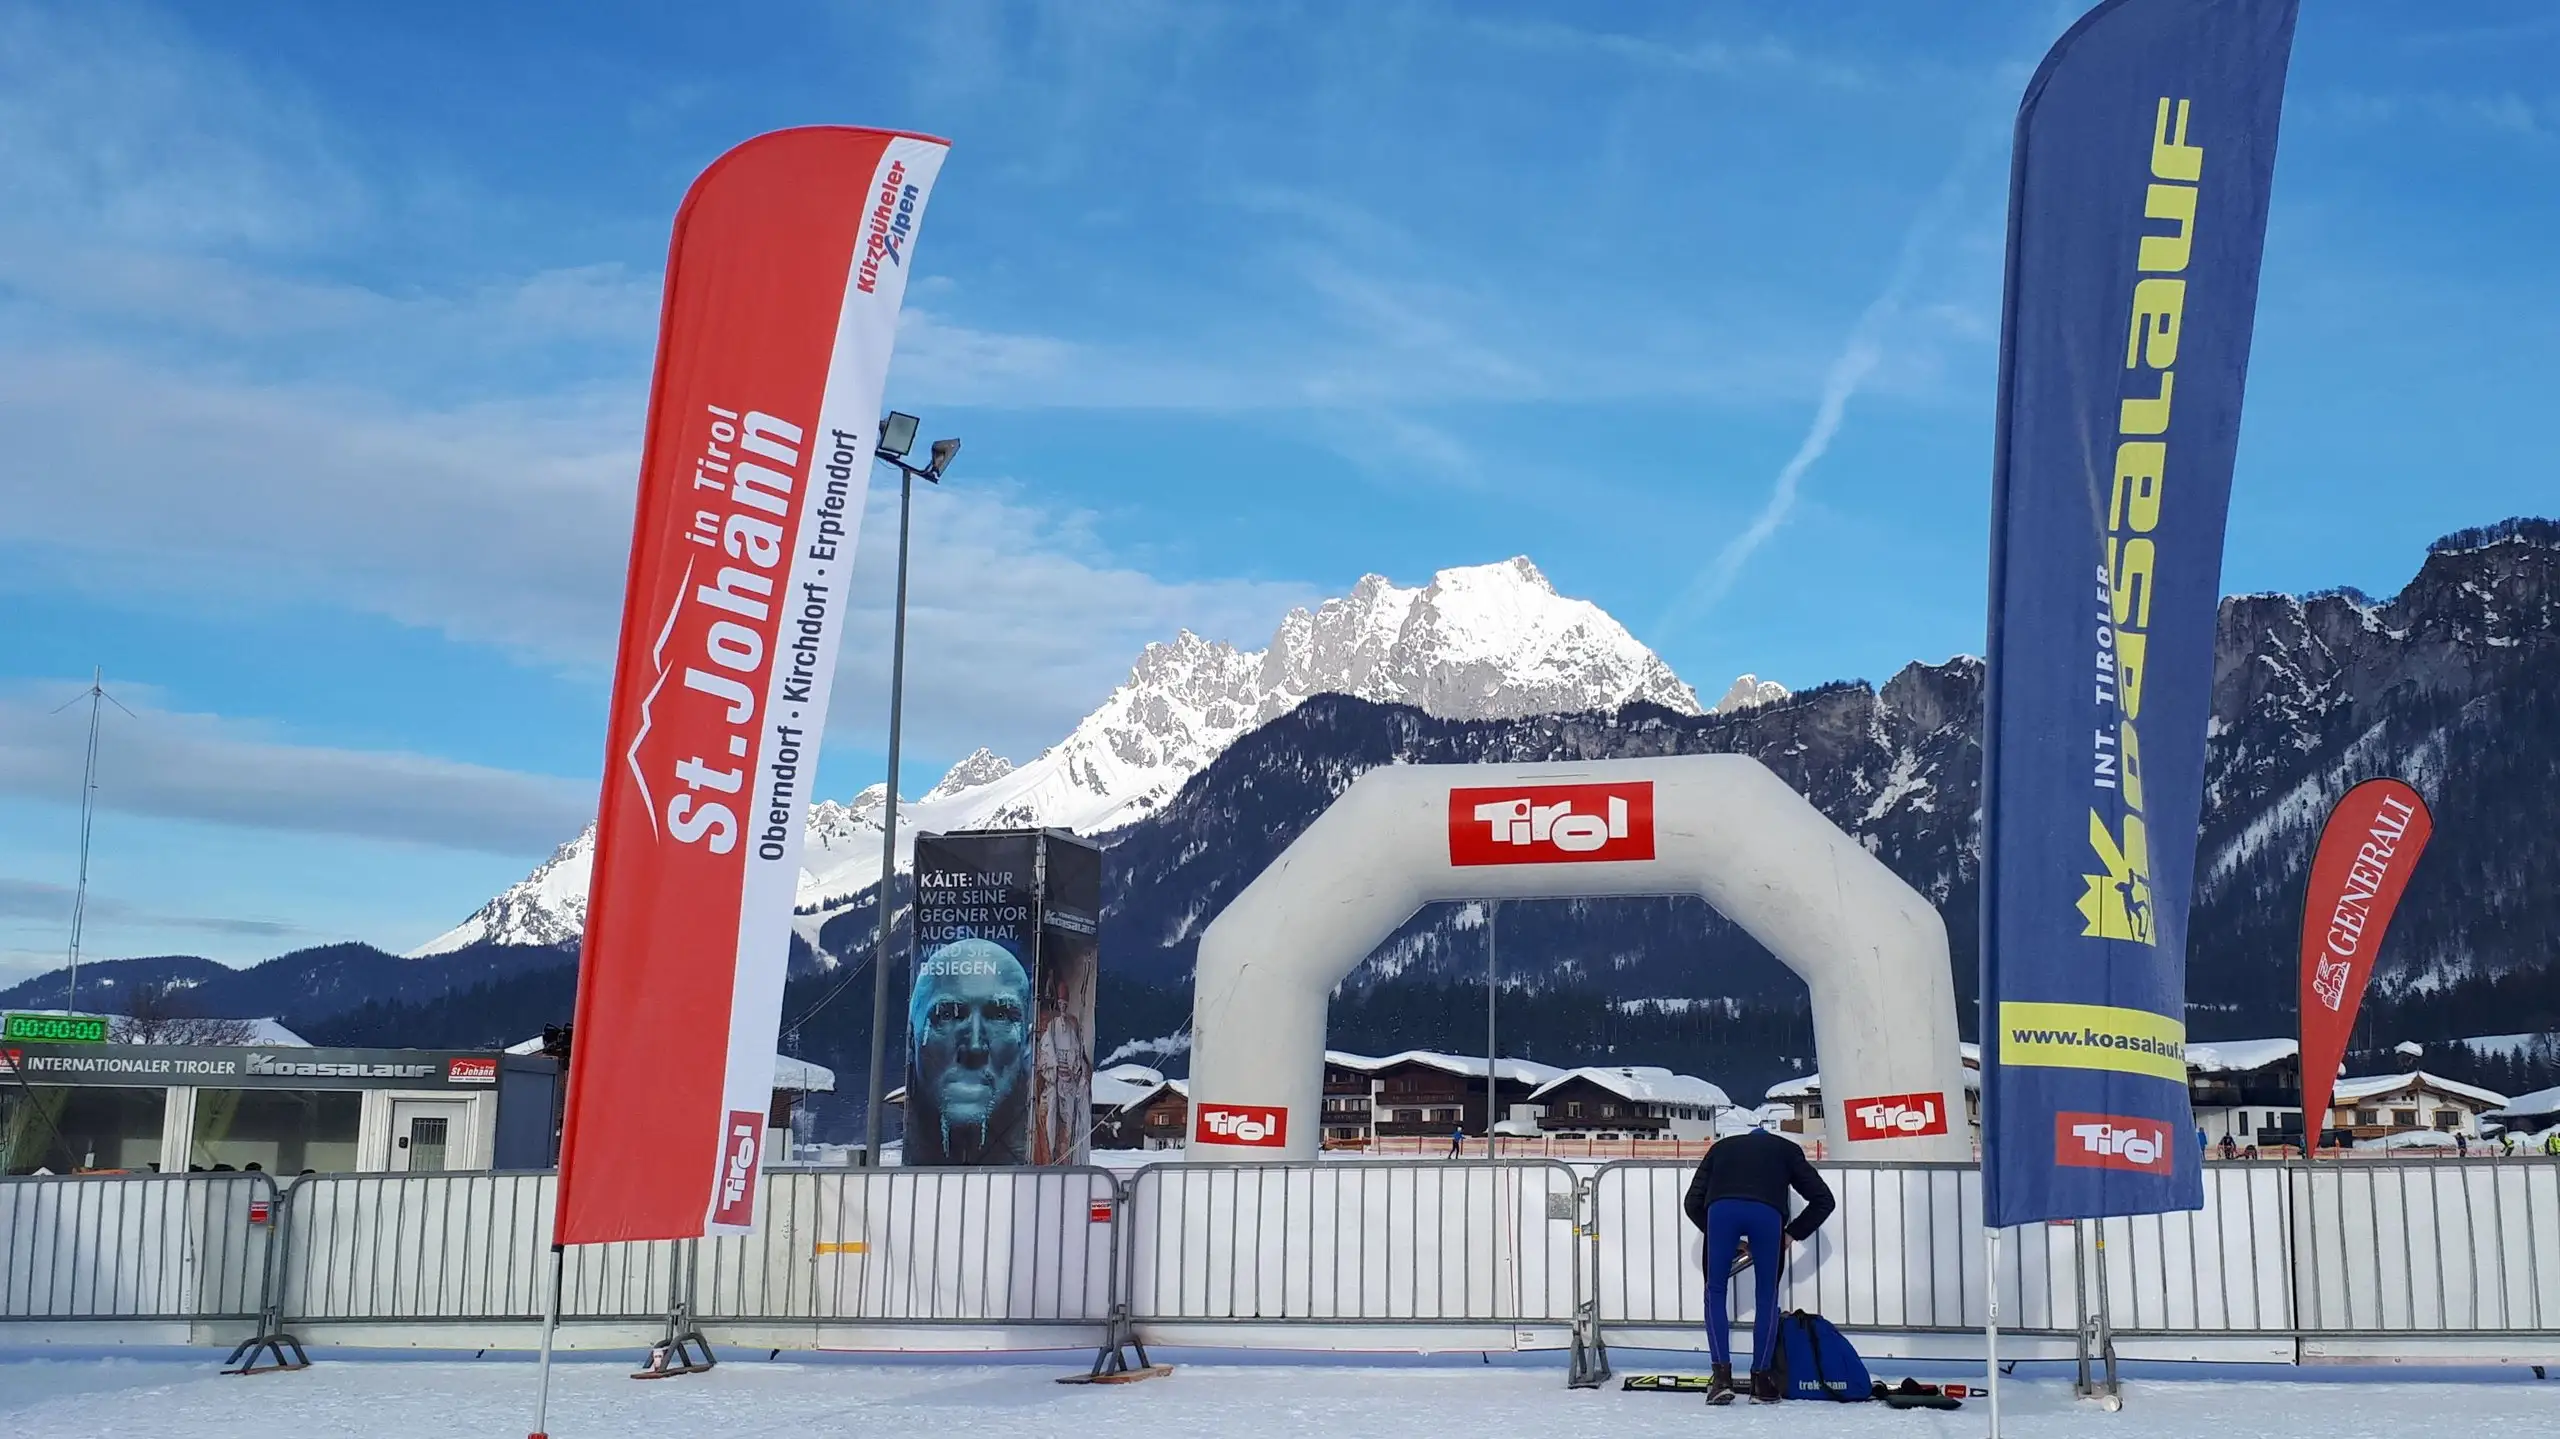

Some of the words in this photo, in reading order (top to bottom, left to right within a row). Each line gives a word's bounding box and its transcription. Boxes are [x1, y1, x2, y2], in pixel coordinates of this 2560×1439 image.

[857, 160, 907, 294] Kitzbüheler
[694, 404, 739, 490] Tirol
[685, 509, 720, 547] in
[759, 726, 803, 861] Oberndorf
[783, 582, 829, 703] Kirchdorf
[809, 429, 858, 562] Erpfendorf
[2095, 563, 2114, 706] TIROLER
[2095, 724, 2115, 789] INT.
[1474, 795, 1628, 851] Tirol
[920, 870, 972, 888] KÄLTE:
[977, 872, 1013, 886] NUR
[2327, 794, 2414, 956] GENERALI
[920, 891, 957, 905] WER
[962, 889, 1006, 904] SEINE
[920, 908, 989, 922] GEGNER
[993, 907, 1027, 920] VOR
[920, 926, 979, 940] AUGEN
[984, 925, 1019, 940] HAT,
[921, 943, 961, 958] WIRD
[920, 961, 1001, 976] BESIEGEN.
[12, 1019, 101, 1039] 00:00:00
[27, 1057, 170, 1074] INTERNATIONALER
[174, 1060, 236, 1075] TIROLER
[1204, 1111, 1276, 1141] Tirol
[1855, 1101, 1936, 1131] Tirol
[2072, 1124, 2163, 1164] Tirol
[722, 1125, 755, 1210] Tirol
